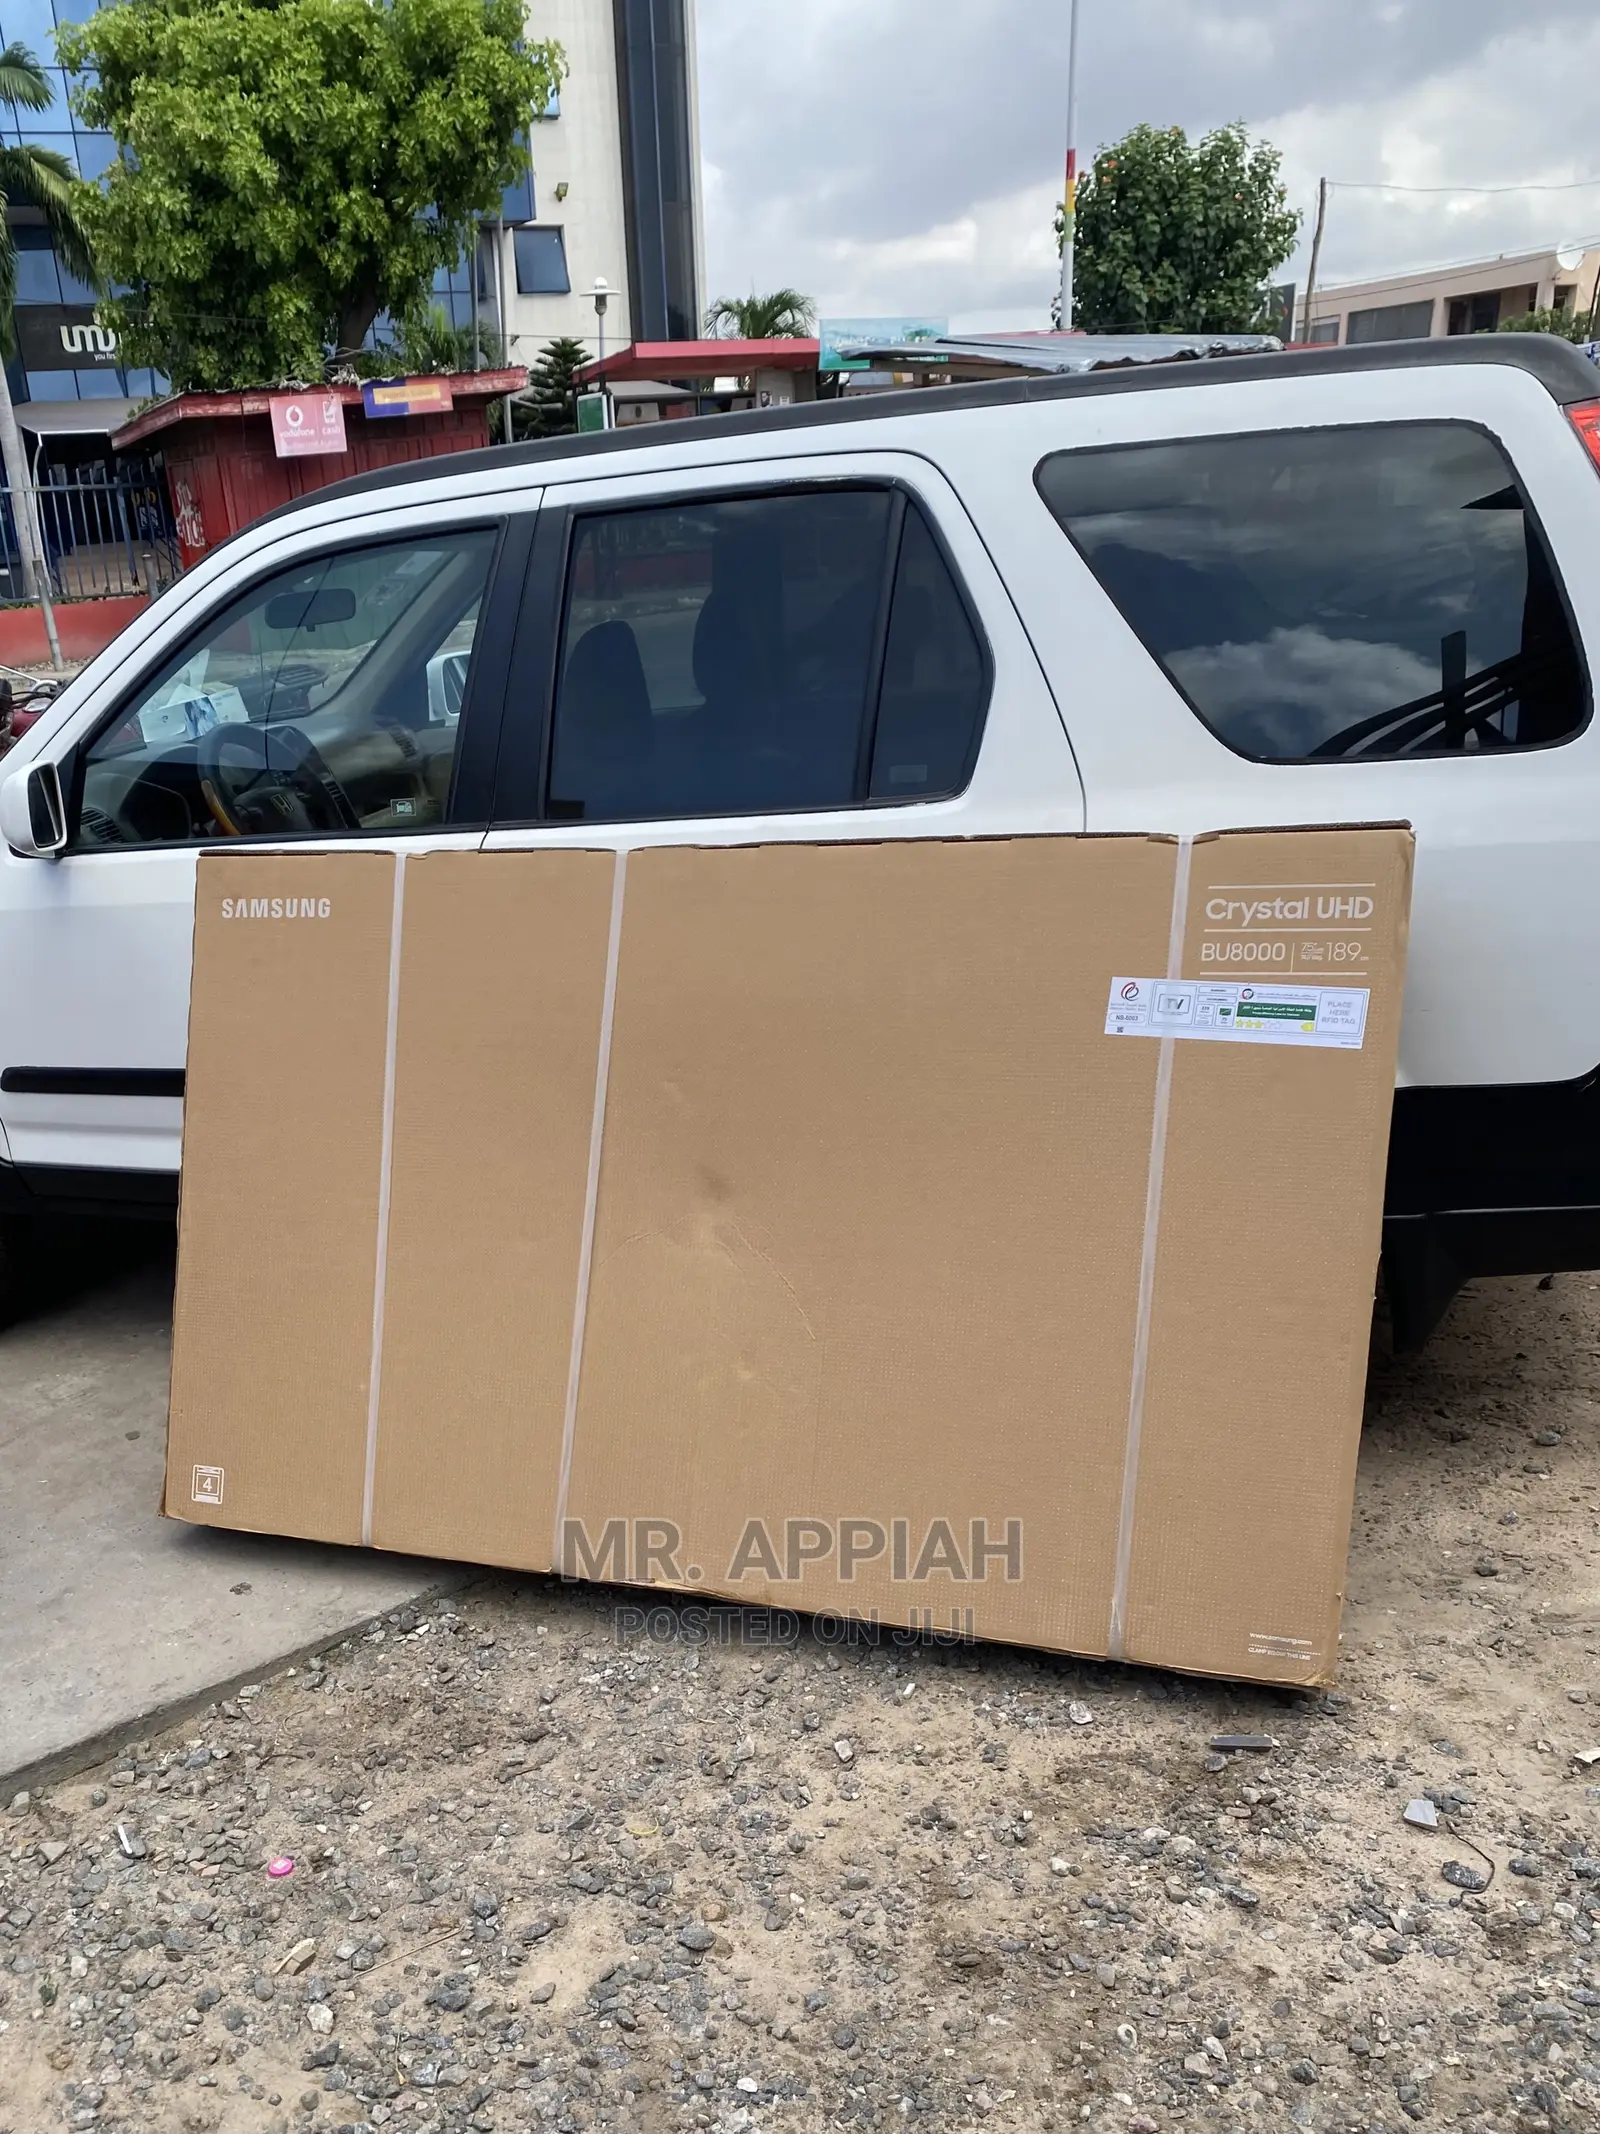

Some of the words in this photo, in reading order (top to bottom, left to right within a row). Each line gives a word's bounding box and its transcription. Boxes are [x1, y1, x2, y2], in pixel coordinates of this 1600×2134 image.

[279, 428, 315, 438] vodafone
[321, 425, 341, 436] cash
[221, 898, 331, 919] SAMSUNG
[1206, 897, 1310, 927] Crystal
[1317, 896, 1374, 919] UHD
[1201, 942, 1286, 961] BU8000
[1328, 1001, 1353, 1009] PLACE
[203, 1477, 212, 1492] 4
